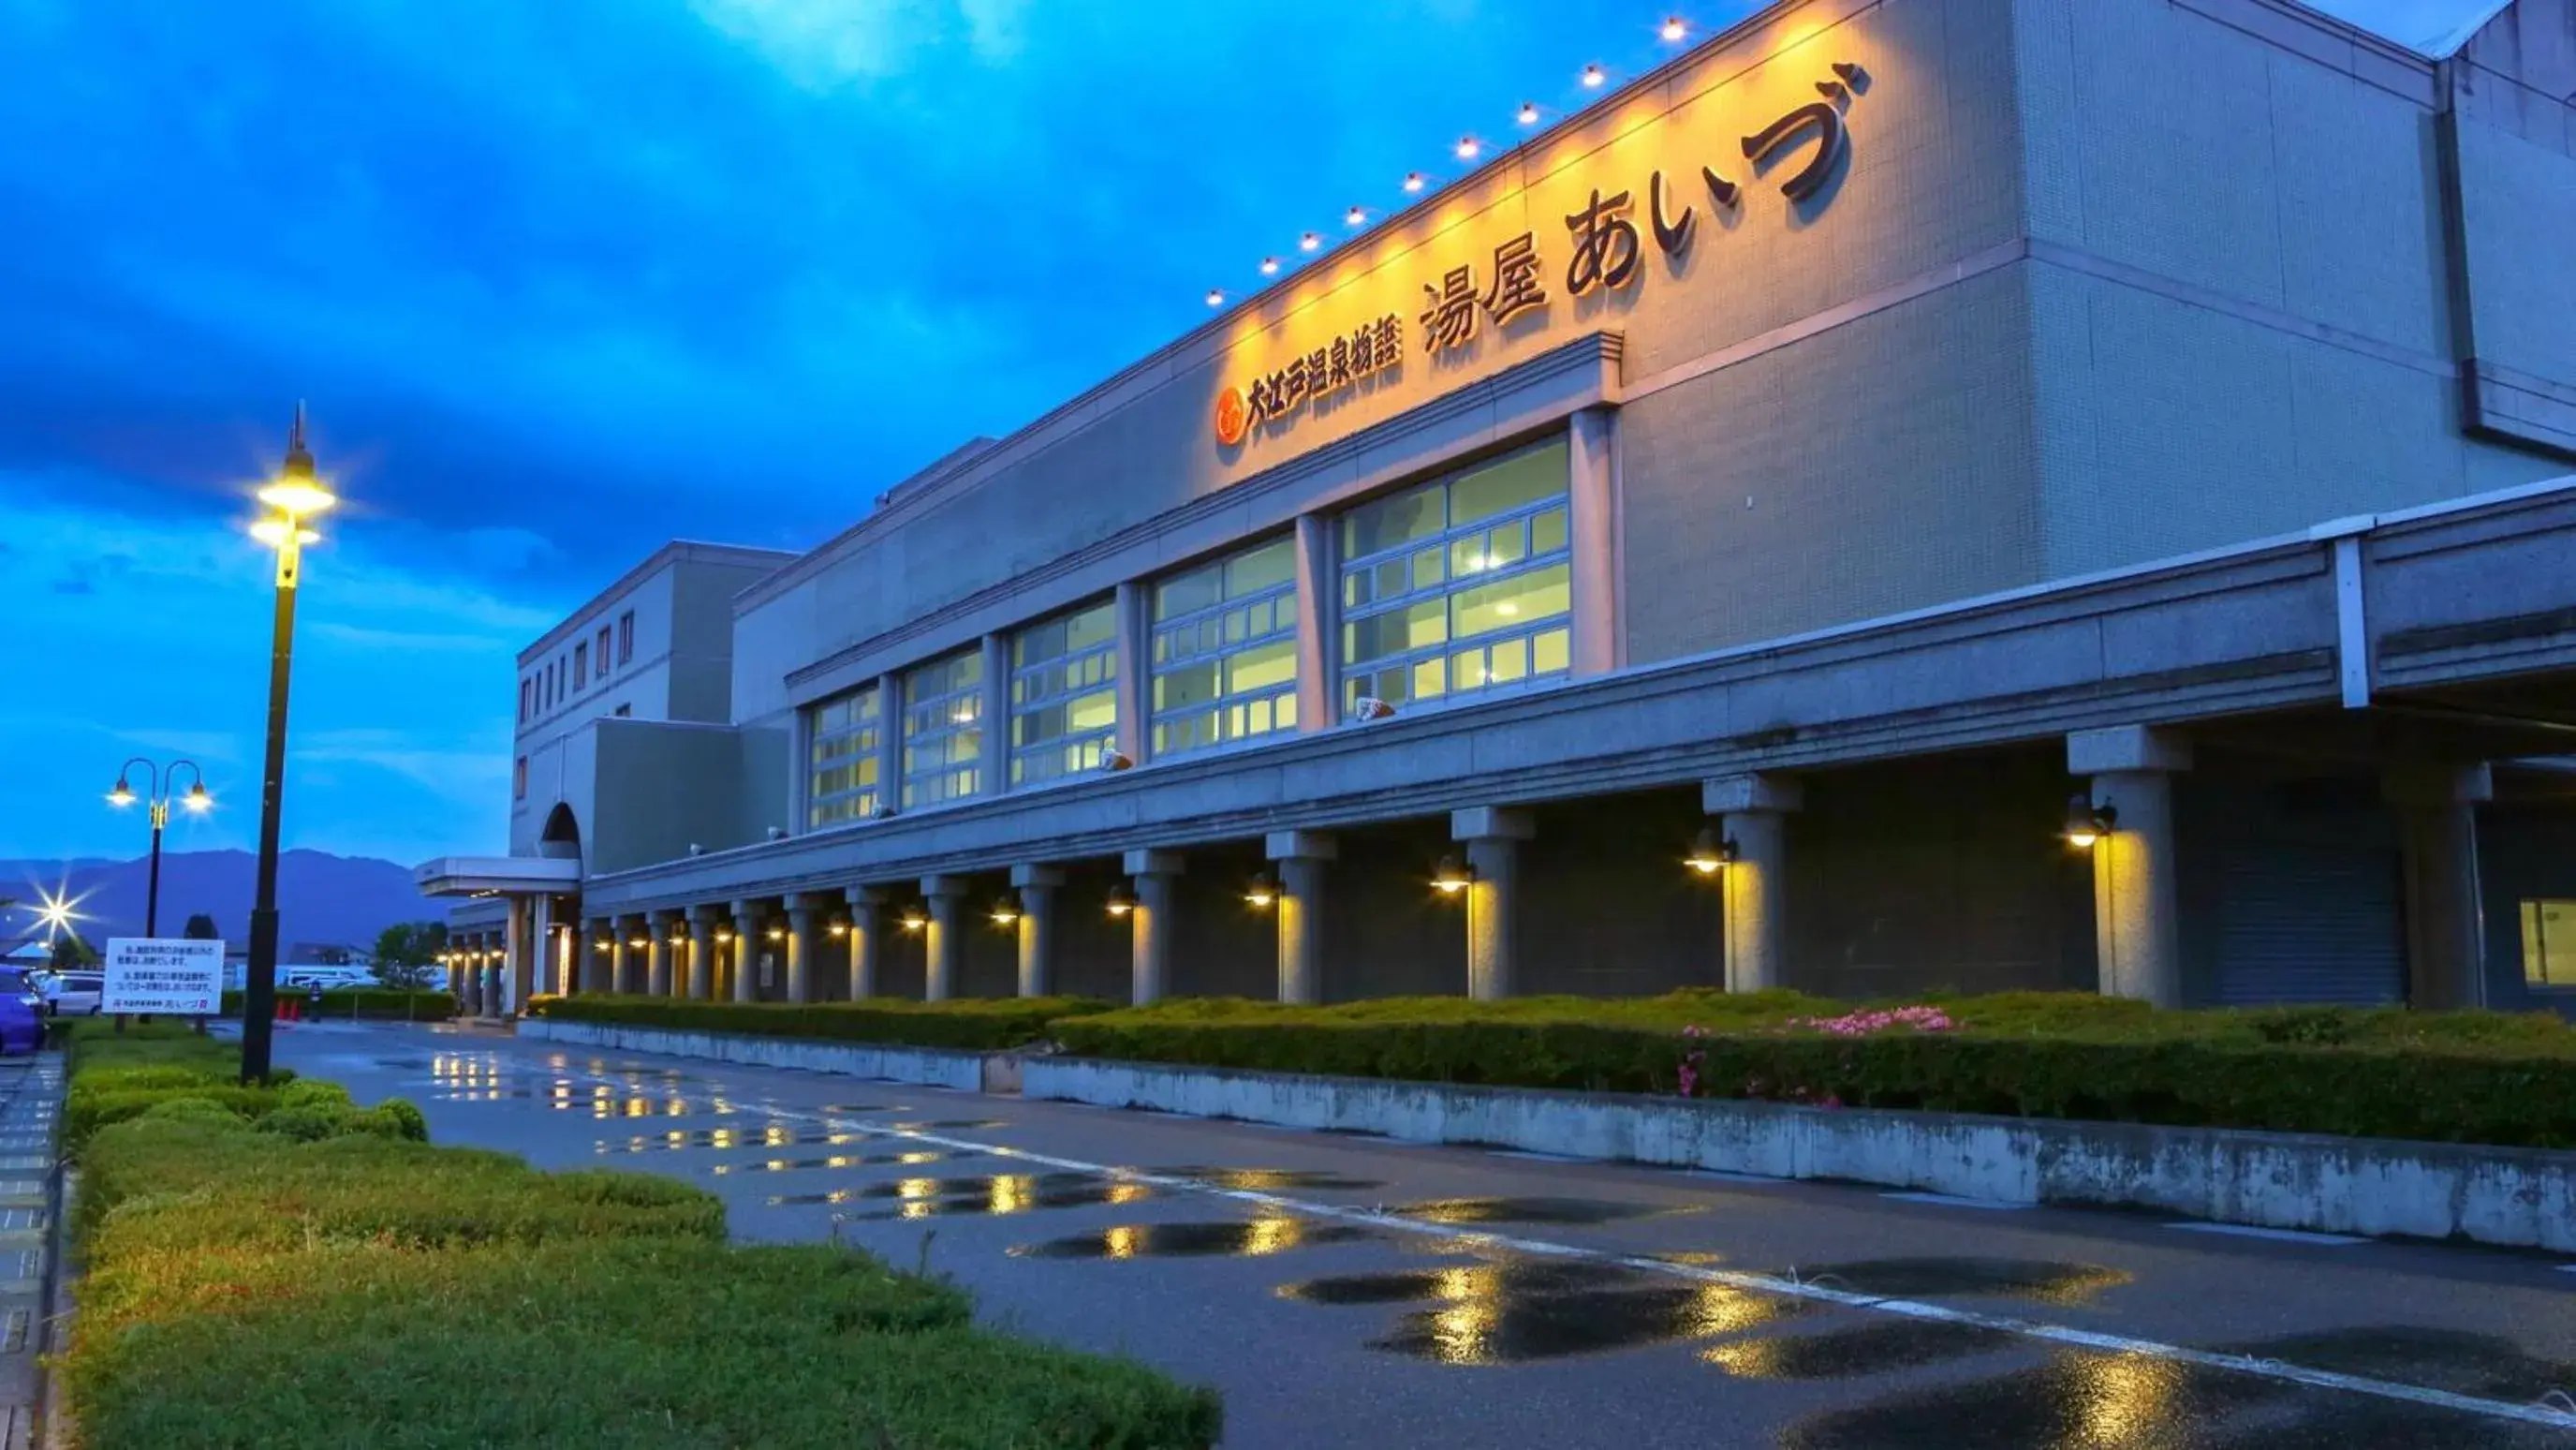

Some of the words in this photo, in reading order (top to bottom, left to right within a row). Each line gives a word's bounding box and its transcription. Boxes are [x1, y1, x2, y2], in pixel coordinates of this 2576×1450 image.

[1246, 313, 1400, 428] 大江戸温泉物語
[1420, 230, 1547, 354] 湯屋
[1565, 62, 1865, 295] あいづ
